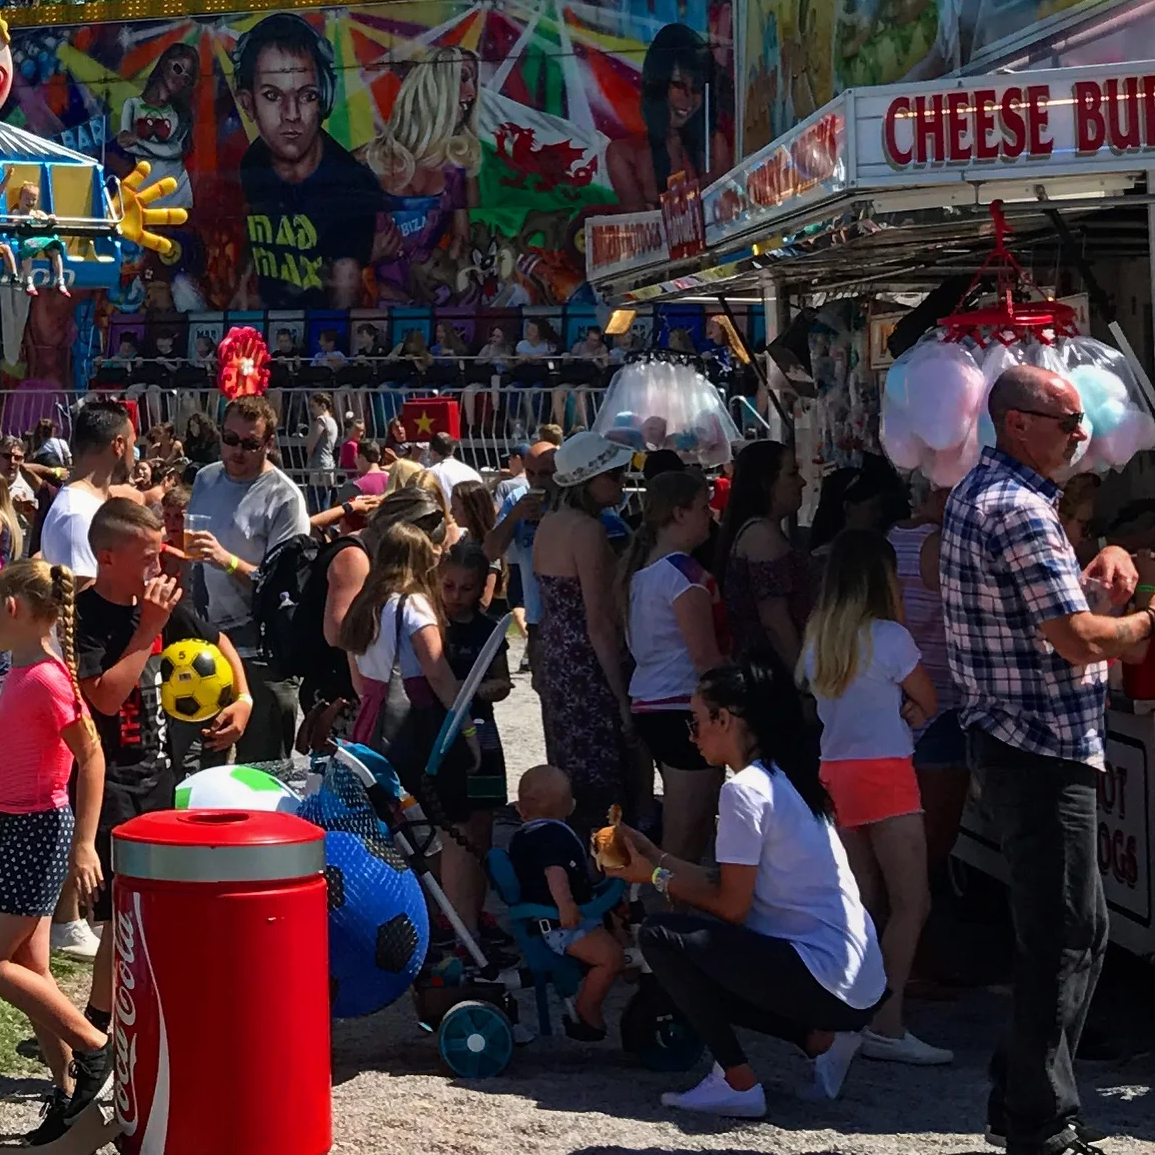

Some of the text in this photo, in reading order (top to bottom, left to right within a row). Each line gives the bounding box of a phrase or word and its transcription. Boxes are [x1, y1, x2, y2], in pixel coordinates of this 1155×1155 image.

[881, 84, 1054, 170] CHEESE
[246, 213, 317, 250] MAD
[251, 247, 323, 291] MAX
[178, 650, 186, 660] 5
[1096, 759, 1128, 820] OT
[1096, 821, 1139, 889] OGS
